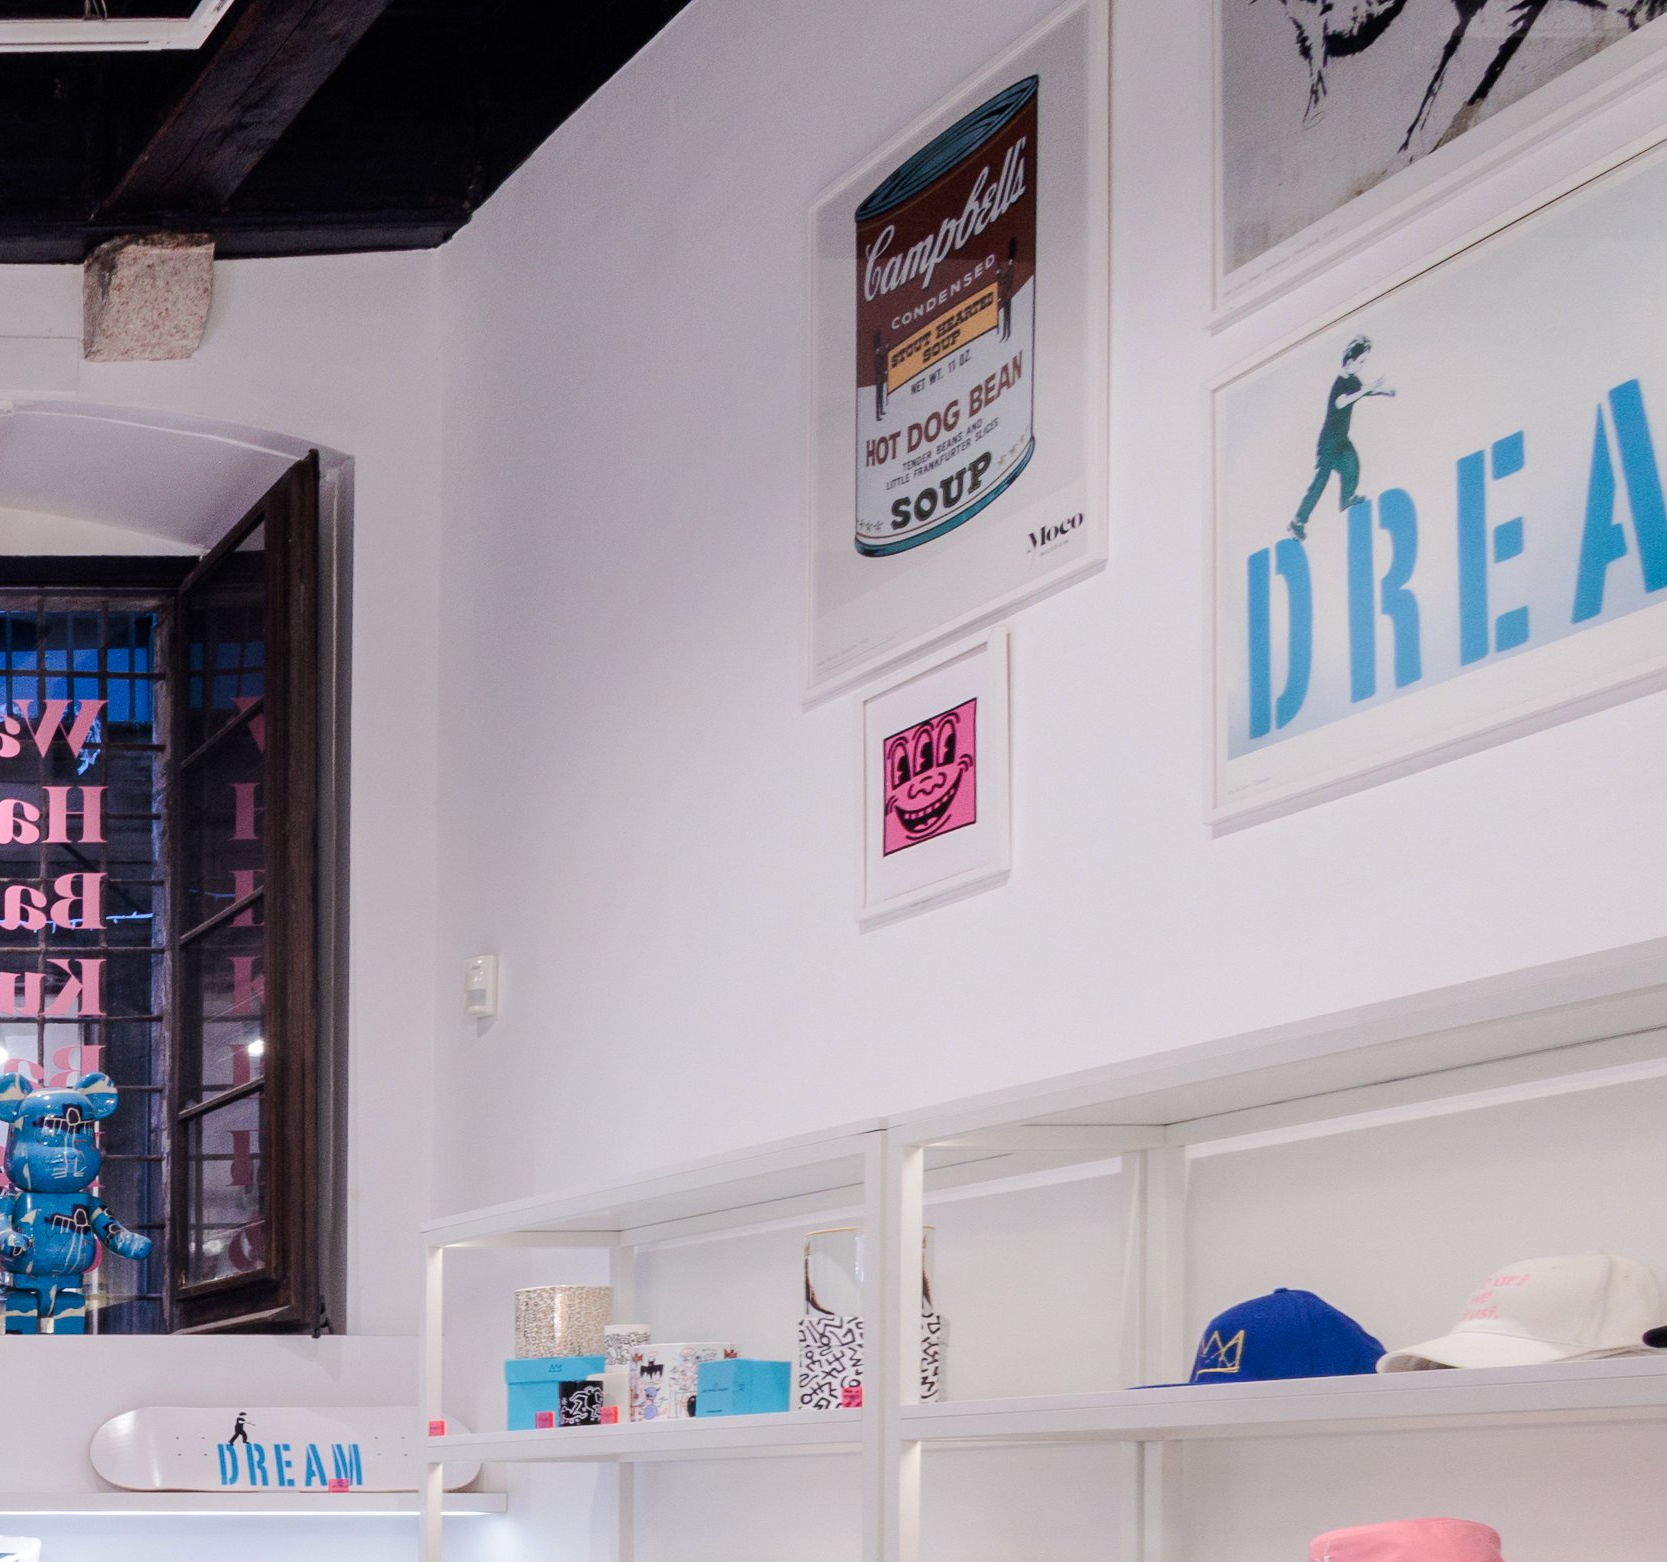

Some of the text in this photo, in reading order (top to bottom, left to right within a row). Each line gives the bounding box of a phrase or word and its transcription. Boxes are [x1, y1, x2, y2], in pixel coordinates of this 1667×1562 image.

[891, 253, 997, 330] CONDENSED
[890, 291, 995, 369] STOUT HEARTED
[922, 330, 961, 363] SOUP
[866, 349, 1024, 468] HOT DOG BEAN
[910, 378, 926, 396] NET
[886, 416, 1000, 491] LITTLE FRANKFURTER SLICES
[902, 418, 984, 473] TENDER BEANS AND
[891, 450, 993, 532] SOUP
[1026, 511, 1085, 554] Moco
[1493, 1273, 1532, 1288] art
[217, 1442, 364, 1488] DREAM
